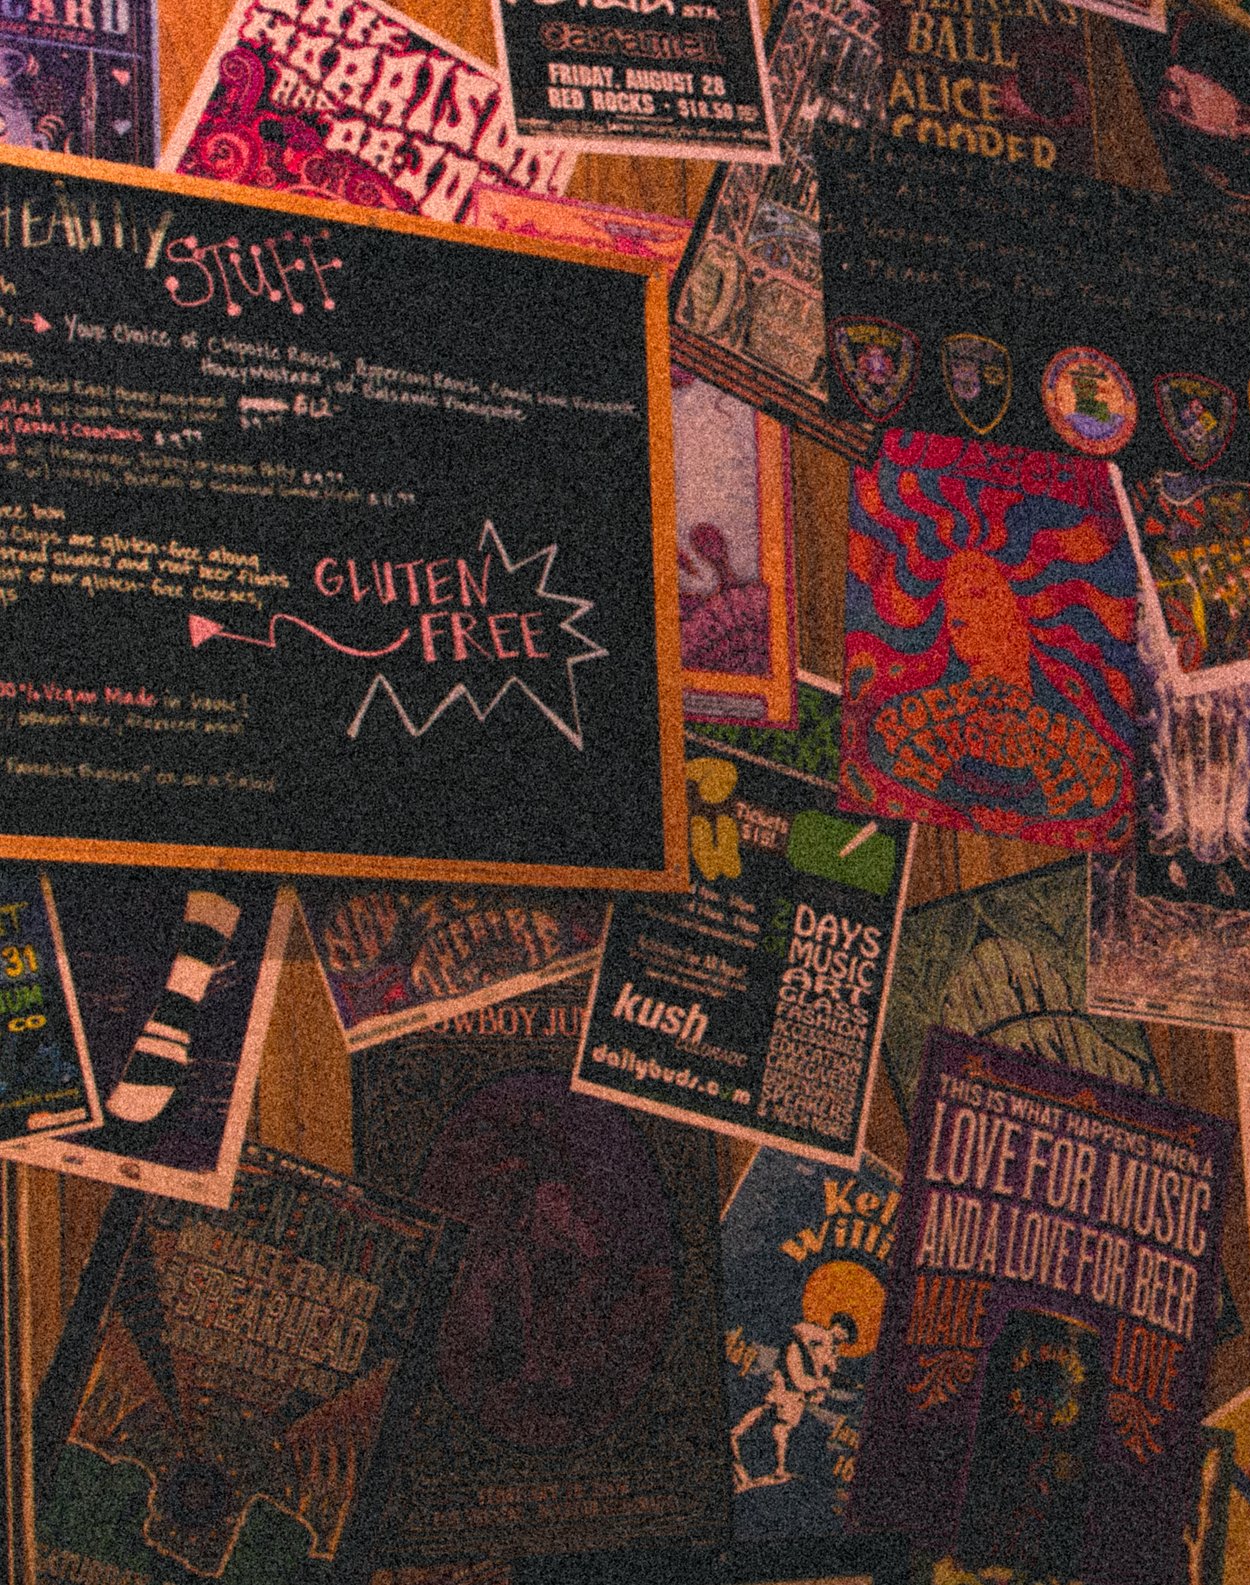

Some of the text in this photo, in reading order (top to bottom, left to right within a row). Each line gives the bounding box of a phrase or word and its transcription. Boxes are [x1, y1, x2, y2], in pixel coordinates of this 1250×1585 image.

[907, 10, 1019, 69] BALL
[547, 86, 585, 111] RED
[590, 89, 656, 115] ROCKS
[625, 68, 696, 94] AUGUST
[889, 69, 1003, 122] ALICE
[163, 226, 343, 318] STUFF
[180, 328, 199, 349] of
[312, 553, 493, 608] GLUTEN
[418, 610, 550, 663] FREE
[793, 902, 882, 960] DAYS
[782, 967, 870, 1006] ART
[788, 936, 877, 989] MUSIC
[424, 1004, 539, 1037] OWBOY
[612, 980, 710, 1045] kush
[775, 1001, 867, 1042] FASHION
[778, 985, 869, 1026] GLASS
[769, 1035, 862, 1077] EDUCATION
[760, 1084, 855, 1126] SPEAKERS
[939, 1073, 1214, 1177] THIS IS WHAT HAPPENS WHEN A
[925, 1101, 1212, 1259] LOVE FOR MUSIC
[916, 1190, 1201, 1341] AND A LOVE FOR BEER
[174, 1262, 370, 1374] SPEARHEAD
[904, 1272, 994, 1350] MAKE
[1110, 1316, 1185, 1413] LOVE
